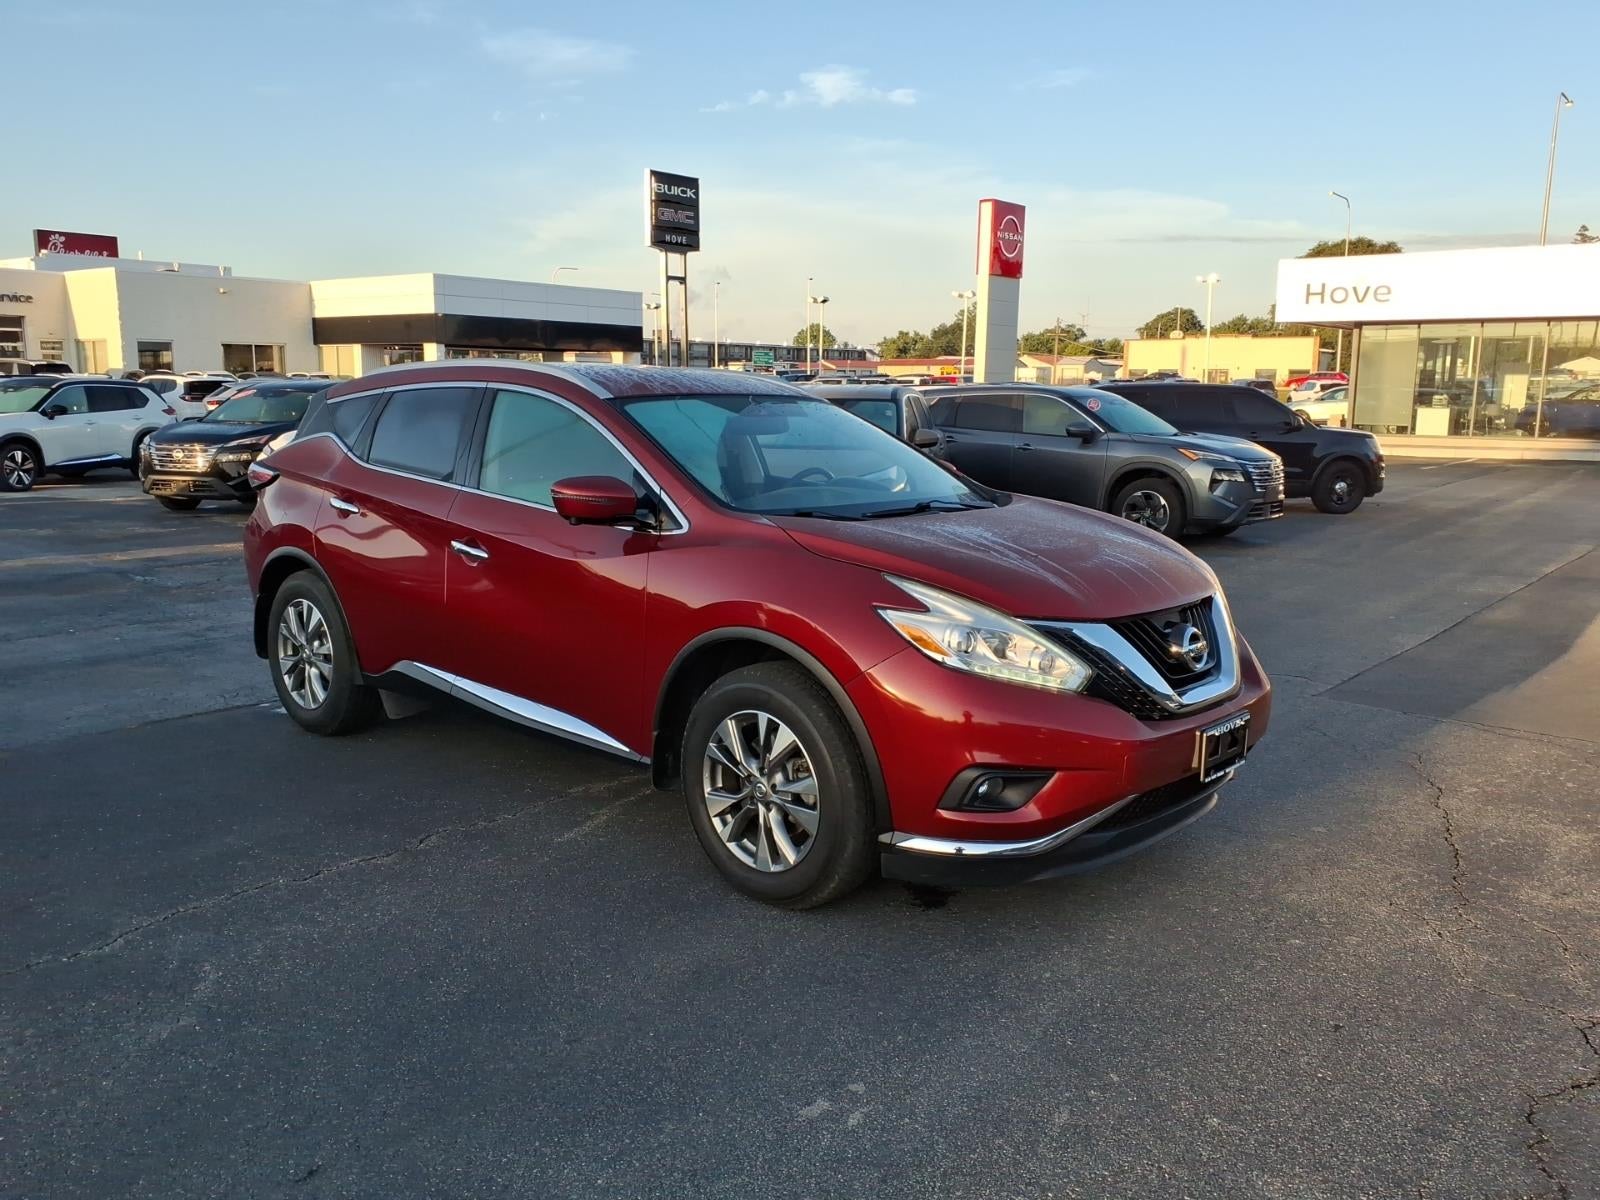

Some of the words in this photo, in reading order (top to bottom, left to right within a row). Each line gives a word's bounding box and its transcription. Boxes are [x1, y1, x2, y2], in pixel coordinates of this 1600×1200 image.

[654, 183, 697, 199] BUICK
[657, 207, 695, 225] GMC
[665, 233, 688, 245] HOVE
[997, 230, 1023, 242] NISSAN
[0, 291, 34, 304] rvice
[1305, 282, 1392, 305] Hove
